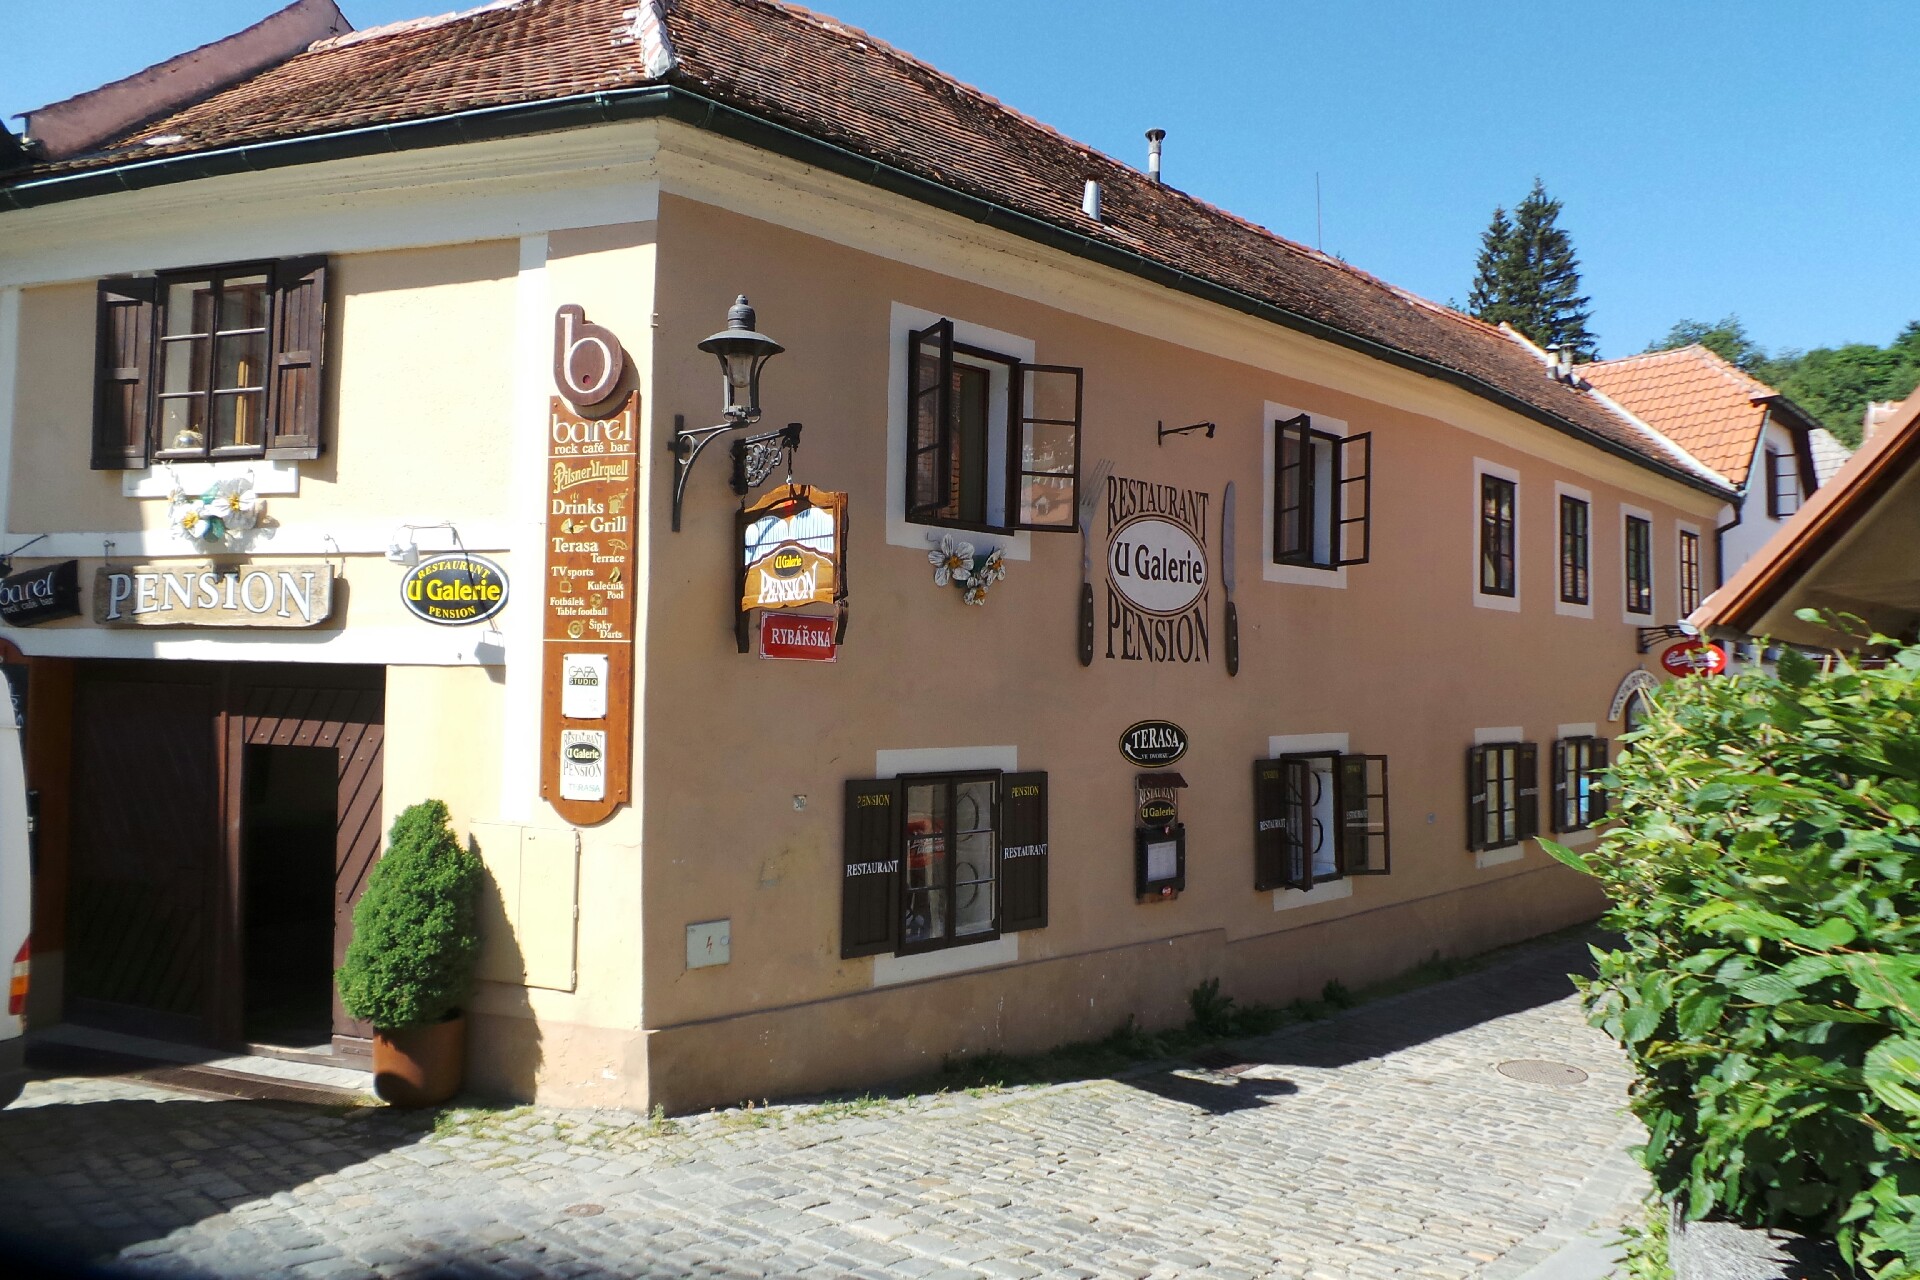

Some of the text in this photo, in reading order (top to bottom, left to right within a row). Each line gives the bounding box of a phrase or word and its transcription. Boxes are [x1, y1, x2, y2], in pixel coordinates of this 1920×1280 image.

[552, 410, 632, 443] barel
[555, 442, 629, 454] rock café bar
[553, 460, 628, 493] Pilsner Urquell
[551, 498, 604, 514] Drinks
[1106, 475, 1209, 548] RESTAURANT
[590, 516, 627, 533] Grill
[552, 537, 598, 553] Terasa
[590, 553, 625, 563] Terrace
[1114, 541, 1203, 585] U Galerie
[418, 561, 490, 579] RESTAURANT
[551, 566, 594, 579] TV sports
[407, 579, 500, 600] U Galerie
[587, 581, 624, 591] Kulečník
[758, 561, 819, 604] PENSION
[105, 570, 316, 623] PENSION
[550, 597, 585, 606] Fotbálek
[607, 591, 624, 599] Pool
[429, 606, 476, 619] PENSION
[556, 607, 607, 616] Table football
[588, 619, 612, 631] Šipky
[1105, 577, 1210, 664] PENSION
[600, 630, 623, 639] Darts
[771, 624, 831, 648] RYBÁŘSKÁ
[569, 678, 598, 686] STUDIO
[563, 733, 603, 748] RESTAURANT
[1131, 728, 1180, 749] TERASA
[566, 749, 600, 759] U Galerie
[563, 759, 602, 777] PENSION
[569, 784, 600, 792] TERASA
[1011, 785, 1039, 798] PENSION
[857, 794, 890, 809] PENSION
[1142, 806, 1175, 818] U Galerie
[1004, 844, 1048, 859] RESTAURANT
[846, 860, 899, 877] RESTAURANT
